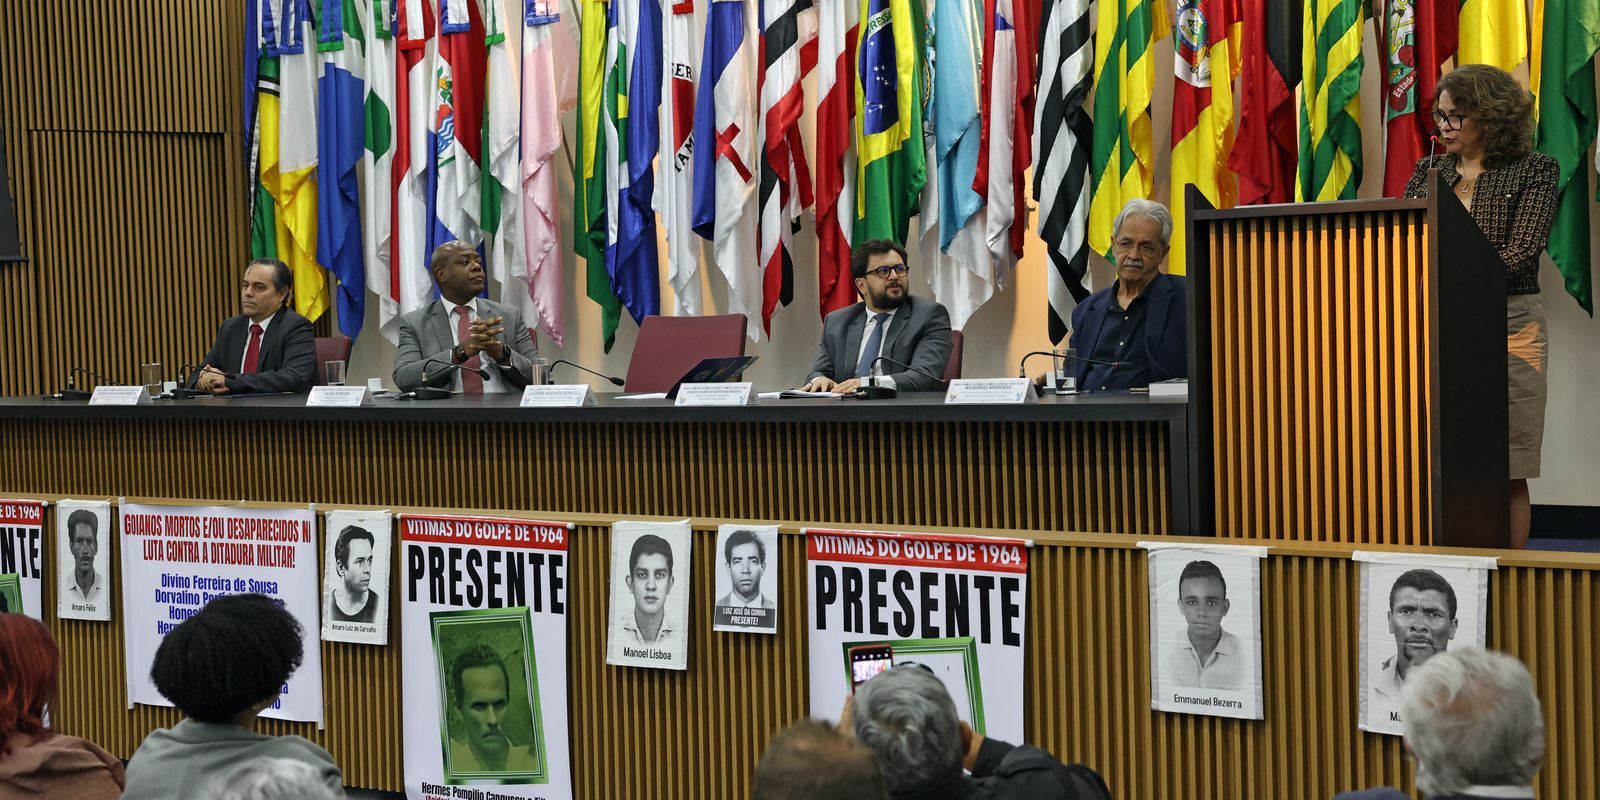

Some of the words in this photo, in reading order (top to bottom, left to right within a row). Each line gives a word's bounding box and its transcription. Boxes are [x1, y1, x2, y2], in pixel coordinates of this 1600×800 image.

[1392, 75, 1415, 98] Estado
[5, 504, 17, 519] DE
[18, 505, 40, 520] 1964
[124, 513, 162, 536] GOIANOS
[164, 515, 200, 538] MORTOS
[203, 517, 225, 540] E/OU
[227, 517, 299, 543] DESAPARECIDOS
[406, 519, 453, 537] VITIMAS
[455, 521, 472, 538] DO
[475, 522, 511, 540] GOLPE
[515, 525, 530, 542] DE
[532, 527, 563, 544] 1964
[143, 539, 164, 561] LUTA
[166, 541, 200, 563] CONTRA
[202, 542, 209, 564] A
[211, 542, 254, 566] DITADURA
[257, 544, 296, 568] MILITAR!
[813, 535, 875, 557] VITIMAS
[878, 537, 900, 558] DO
[903, 539, 953, 562] GOLPE
[956, 542, 976, 563] DE
[979, 543, 1022, 566] 1964
[161, 573, 190, 589] Divino
[193, 575, 231, 591] Ferreira
[234, 577, 245, 592] de
[248, 578, 278, 594] Sousa
[408, 544, 565, 615] PRESENTE
[155, 589, 200, 605] Dorvalino
[814, 564, 1021, 647] PRESENTE
[730, 615, 759, 625] PRESENTE!
[743, 608, 751, 616] DA
[751, 608, 766, 616] CUNHA
[623, 646, 649, 658] Manoel
[649, 648, 672, 660] Lisboa
[1173, 693, 1212, 706] Emmanuel
[1213, 696, 1242, 709] Bezerra
[421, 782, 451, 797] Hermes
